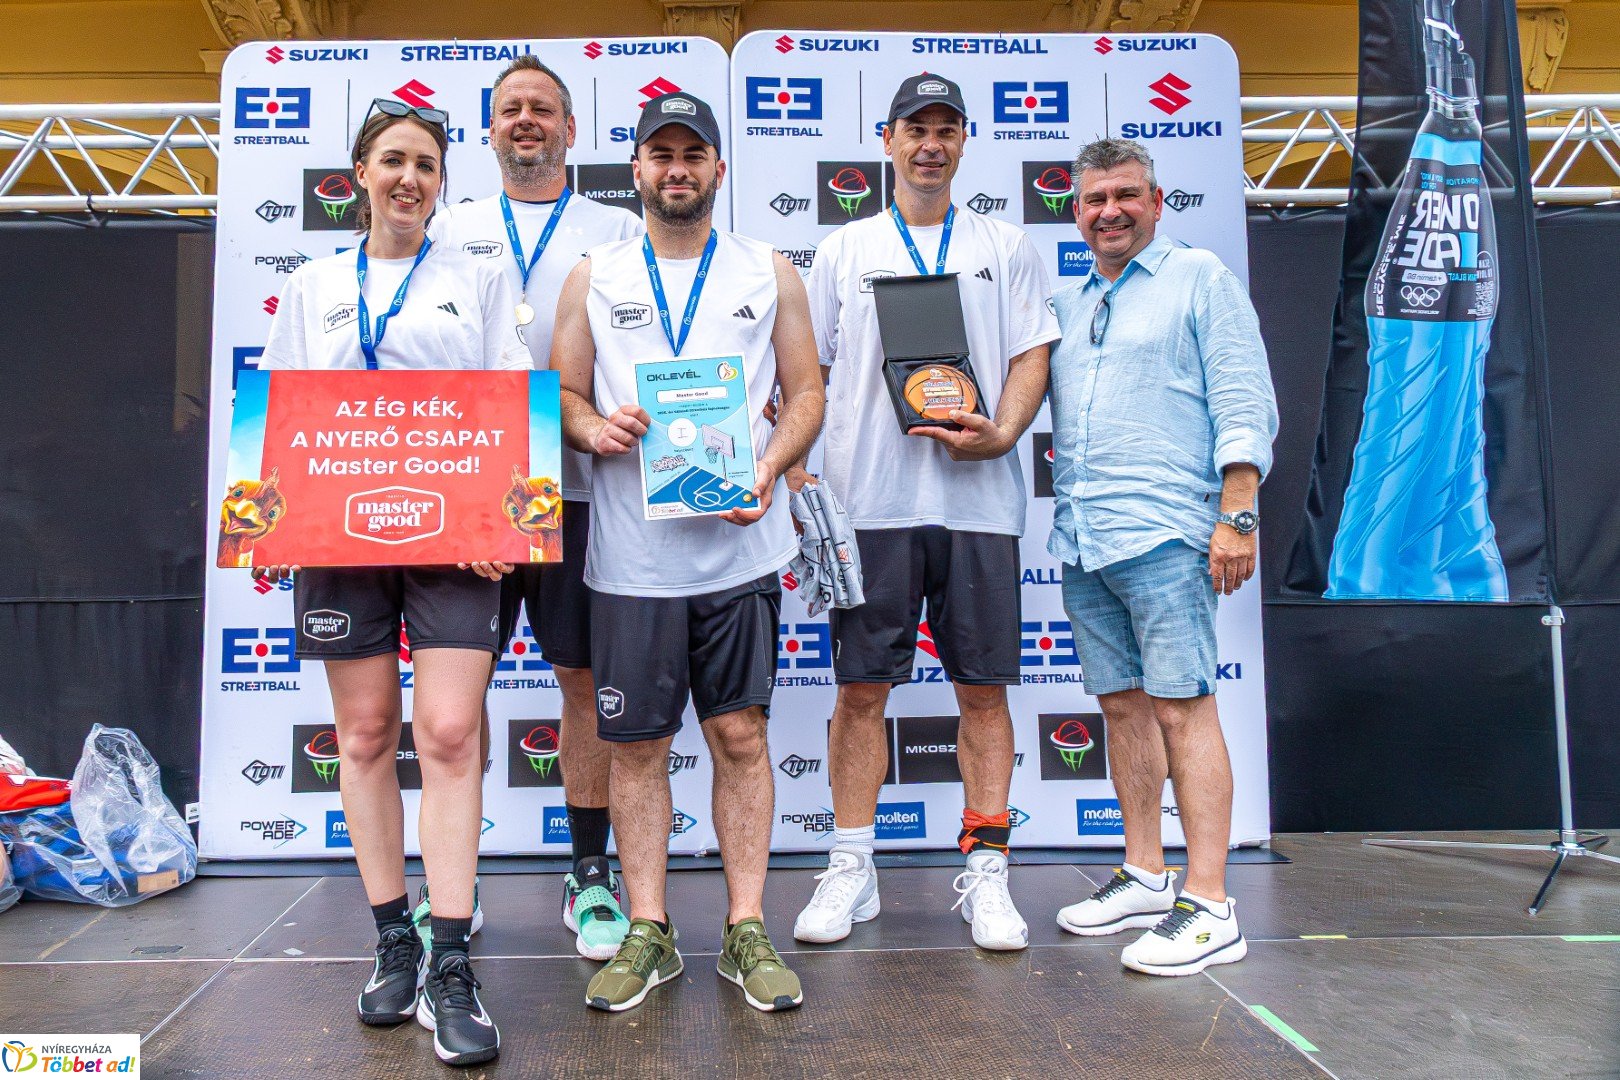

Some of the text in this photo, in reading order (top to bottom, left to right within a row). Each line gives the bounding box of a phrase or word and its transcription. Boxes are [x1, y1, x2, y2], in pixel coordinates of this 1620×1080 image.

[608, 41, 687, 55] SUZUKI
[799, 38, 879, 52] SUZUKI
[912, 38, 1048, 54] STREETBALL
[1118, 38, 1196, 51] SUZUKI
[289, 48, 368, 62] SUZUKI
[746, 126, 823, 137] STREETBALL
[993, 130, 1070, 140] STREETBALL
[1121, 121, 1222, 139] SUZUKI
[233, 135, 310, 145] STREETBALL
[585, 190, 636, 199] MKOSZ
[1173, 193, 1205, 207] TOTI
[779, 198, 811, 212] TOTI
[976, 197, 1008, 210] TOTI
[265, 205, 296, 218] TOTI
[255, 256, 307, 266] POWER
[1064, 250, 1095, 261] molt
[276, 265, 300, 274] AD
[614, 307, 648, 318] master
[619, 313, 643, 325] good
[646, 369, 701, 382] OKLEVÉL
[335, 396, 463, 420] AZ ÉG KÉK,
[290, 425, 504, 448] A NYERŐ CSAPAT
[308, 456, 480, 475] Master Good!
[357, 498, 434, 514] master
[368, 511, 422, 532] good
[308, 616, 345, 626] master
[312, 624, 338, 634] good
[221, 681, 300, 692] STREETBALL
[905, 744, 957, 754] MKOSZ
[790, 759, 822, 772] TOTI
[252, 765, 286, 779] TOTI
[781, 813, 835, 824] POWER
[875, 811, 919, 823] molten
[1083, 807, 1122, 819] molte
[240, 820, 296, 831] POWER
[803, 823, 835, 833] ADE
[262, 830, 296, 840] ADE
